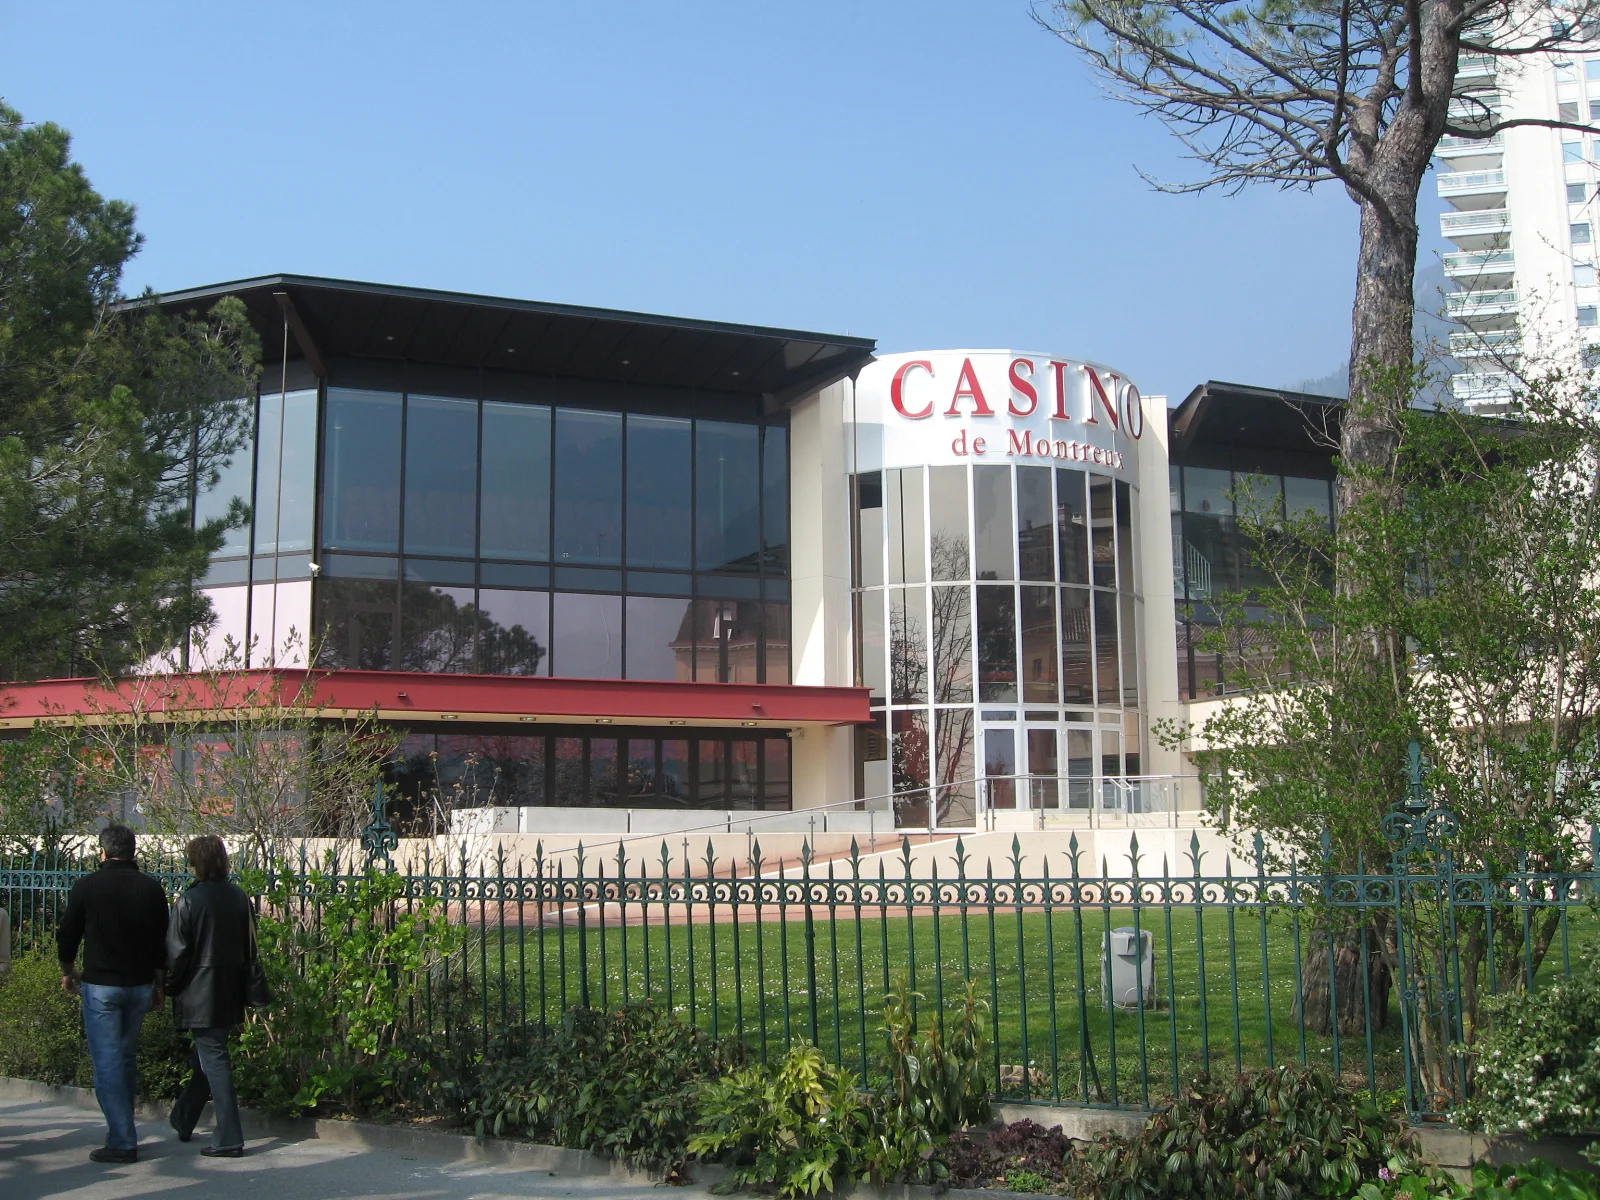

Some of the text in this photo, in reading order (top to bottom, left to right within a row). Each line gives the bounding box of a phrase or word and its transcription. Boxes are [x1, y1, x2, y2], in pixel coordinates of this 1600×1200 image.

[890, 357, 1143, 440] CASINO
[951, 429, 1125, 470] de Montreux
